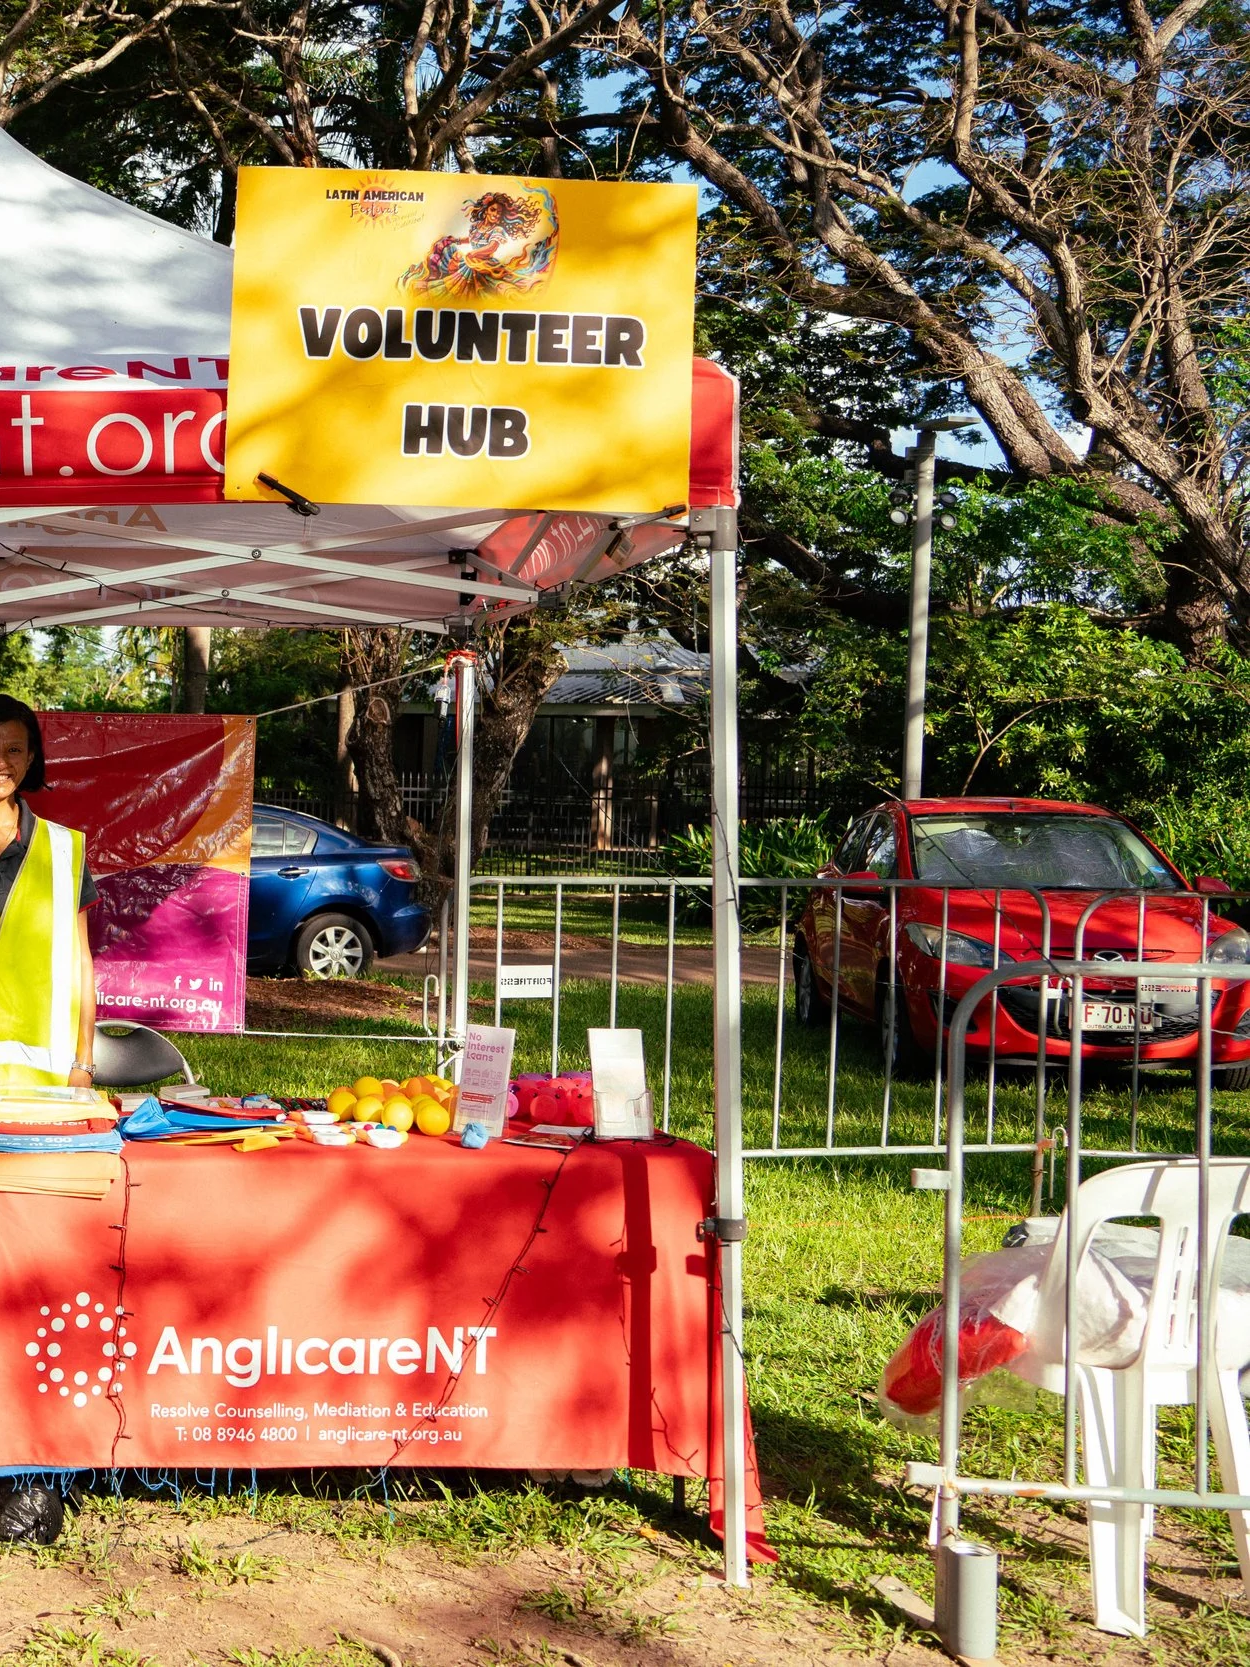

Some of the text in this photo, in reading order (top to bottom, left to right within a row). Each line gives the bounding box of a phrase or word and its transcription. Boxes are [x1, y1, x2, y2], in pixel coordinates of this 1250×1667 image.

[326, 190, 424, 201] LATIN AMERICAN
[350, 203, 399, 218] Festival
[298, 306, 646, 368] VOLUNTEER
[403, 404, 529, 459] HUB
[95, 992, 222, 1013] licare-nt.org.au
[469, 1032, 482, 1041] No
[468, 1042, 505, 1054] Interest
[466, 1052, 494, 1062] Loans
[150, 1402, 488, 1421] Resolve Counselling, Mediation & Education
[175, 1427, 188, 1441] T:
[192, 1427, 212, 1441] 08
[217, 1427, 255, 1441] 8946
[259, 1427, 297, 1441] 4800
[318, 1427, 462, 1444] anglicare-nt.org.au
